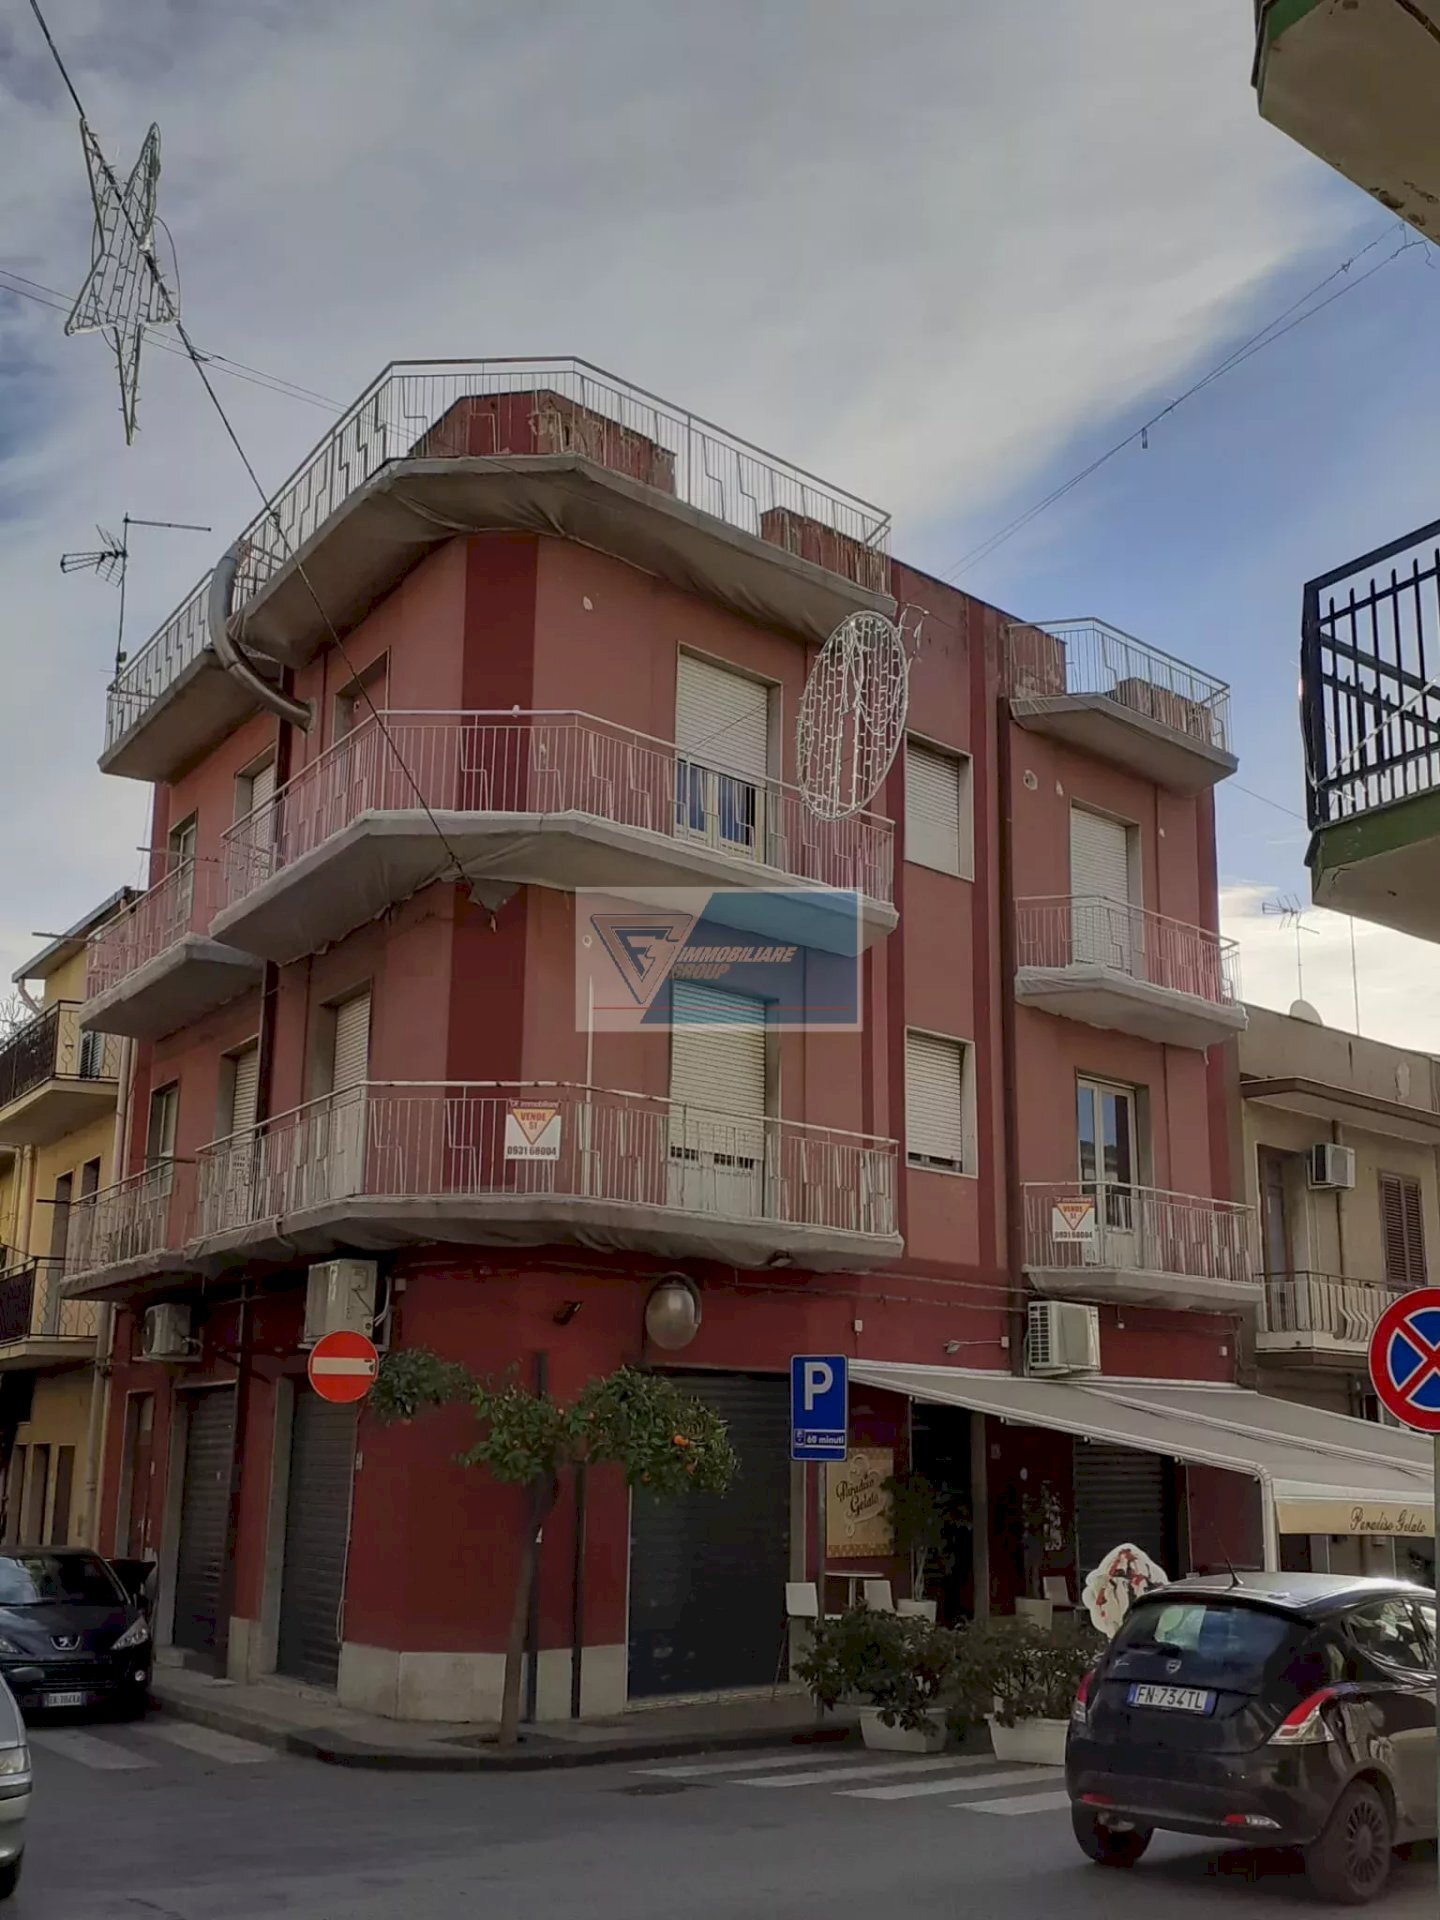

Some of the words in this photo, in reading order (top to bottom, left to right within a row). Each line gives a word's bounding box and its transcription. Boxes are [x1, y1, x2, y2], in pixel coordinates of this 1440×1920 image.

[520, 1112, 546, 1122] VENDE
[804, 1361, 834, 1411] P
[806, 1434, 818, 1445] 60
[818, 1434, 844, 1445] minuti
[850, 1492, 880, 1516] Gelato
[1350, 1506, 1394, 1531] Paradiso
[1395, 1508, 1427, 1532] Gelato
